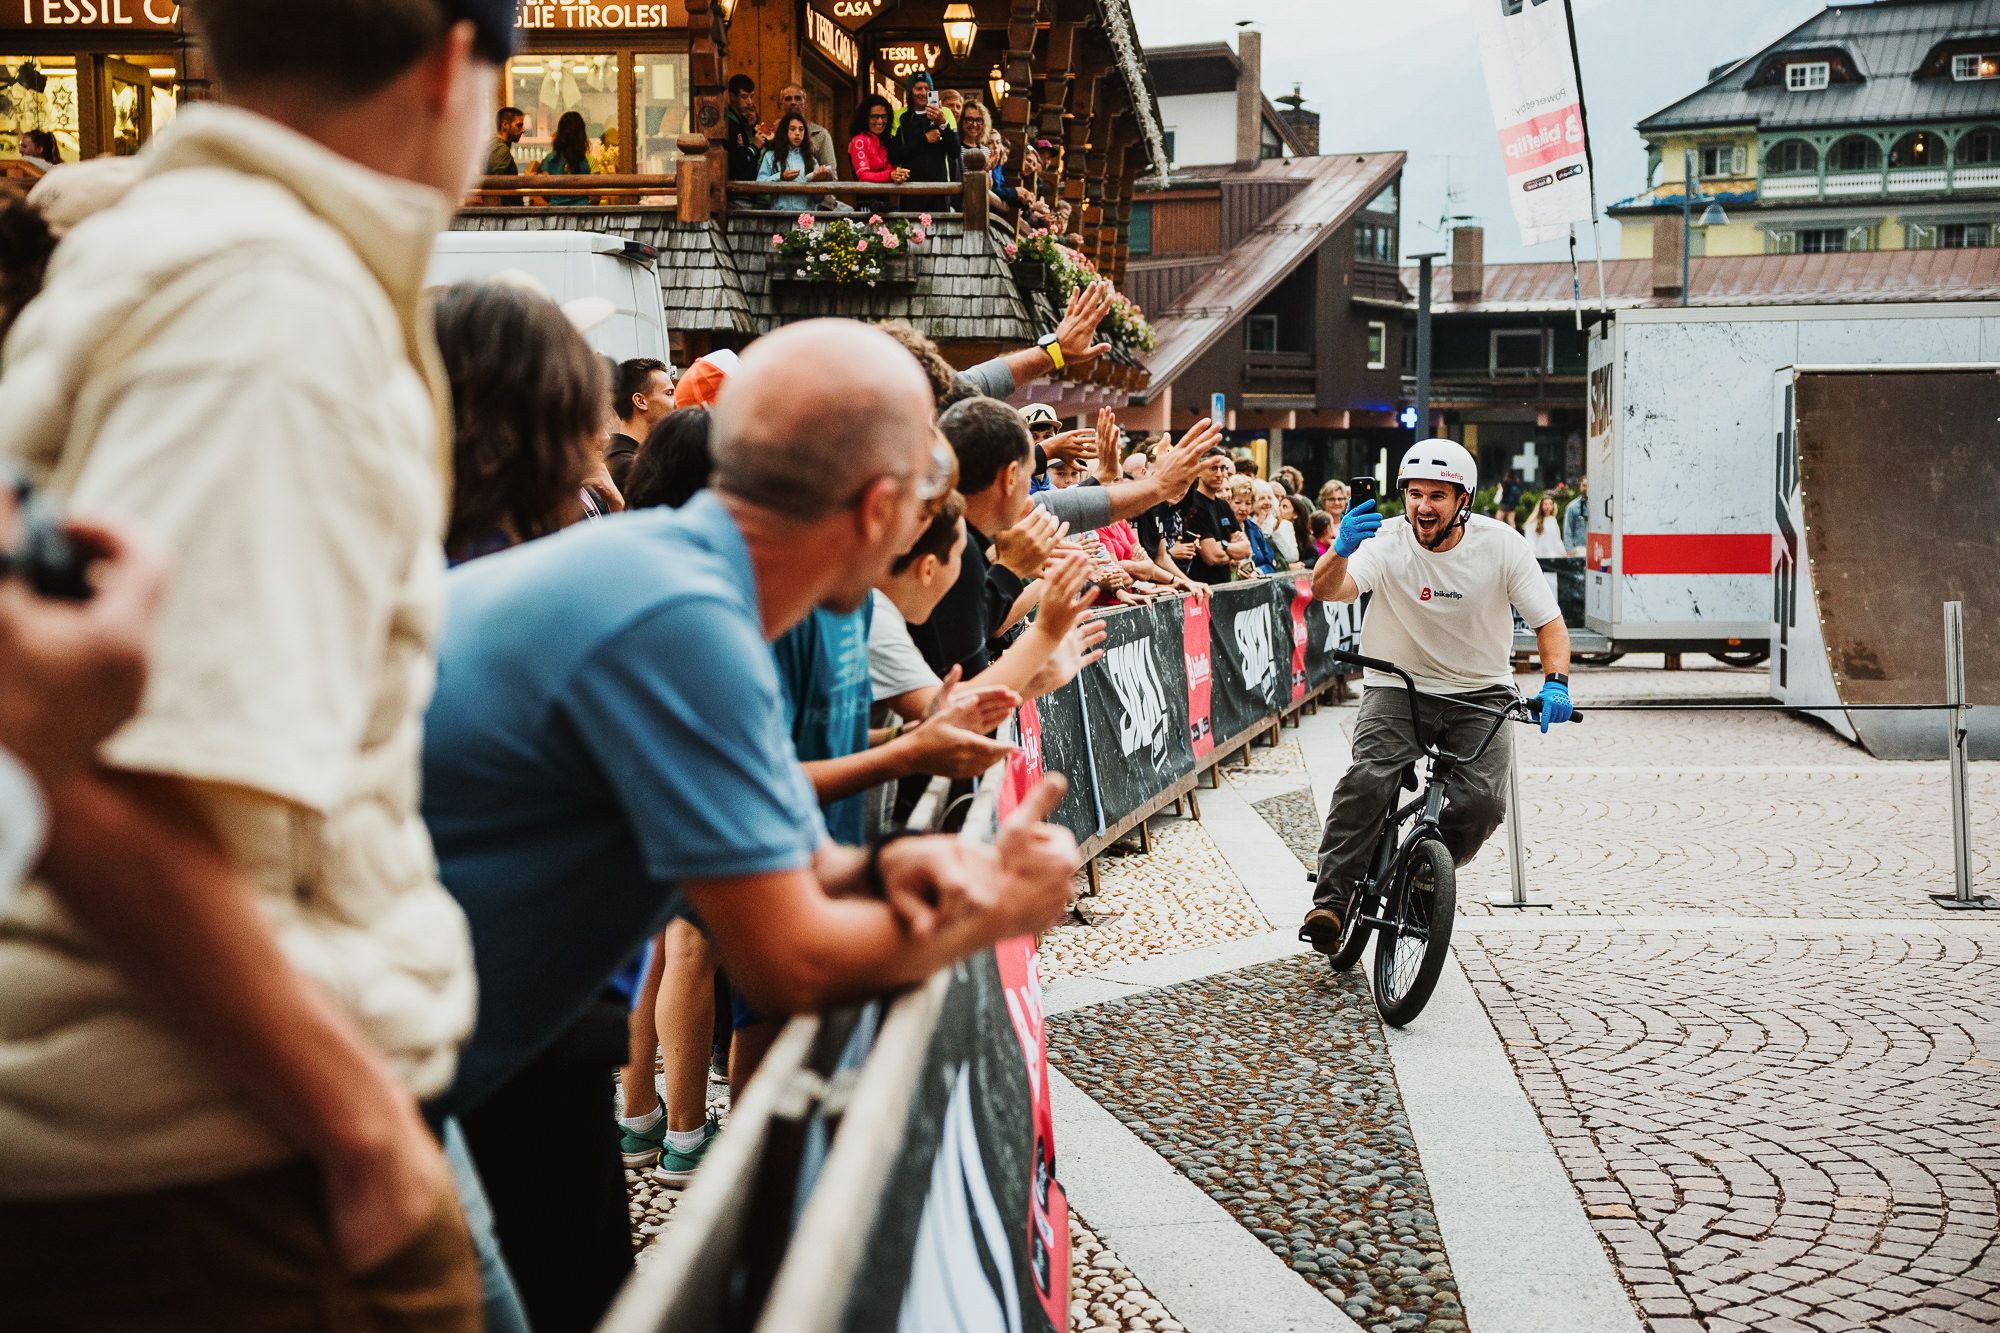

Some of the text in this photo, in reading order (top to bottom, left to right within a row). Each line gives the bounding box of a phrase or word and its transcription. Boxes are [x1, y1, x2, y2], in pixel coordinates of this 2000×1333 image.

[560, 4, 668, 28] TIROLESI
[833, 1, 873, 17] CASA
[814, 11, 852, 70] TESSIL CASA
[879, 47, 919, 61] TESSIL
[1440, 469, 1465, 482] bikeflip
[1433, 589, 1463, 601] bikeflip
